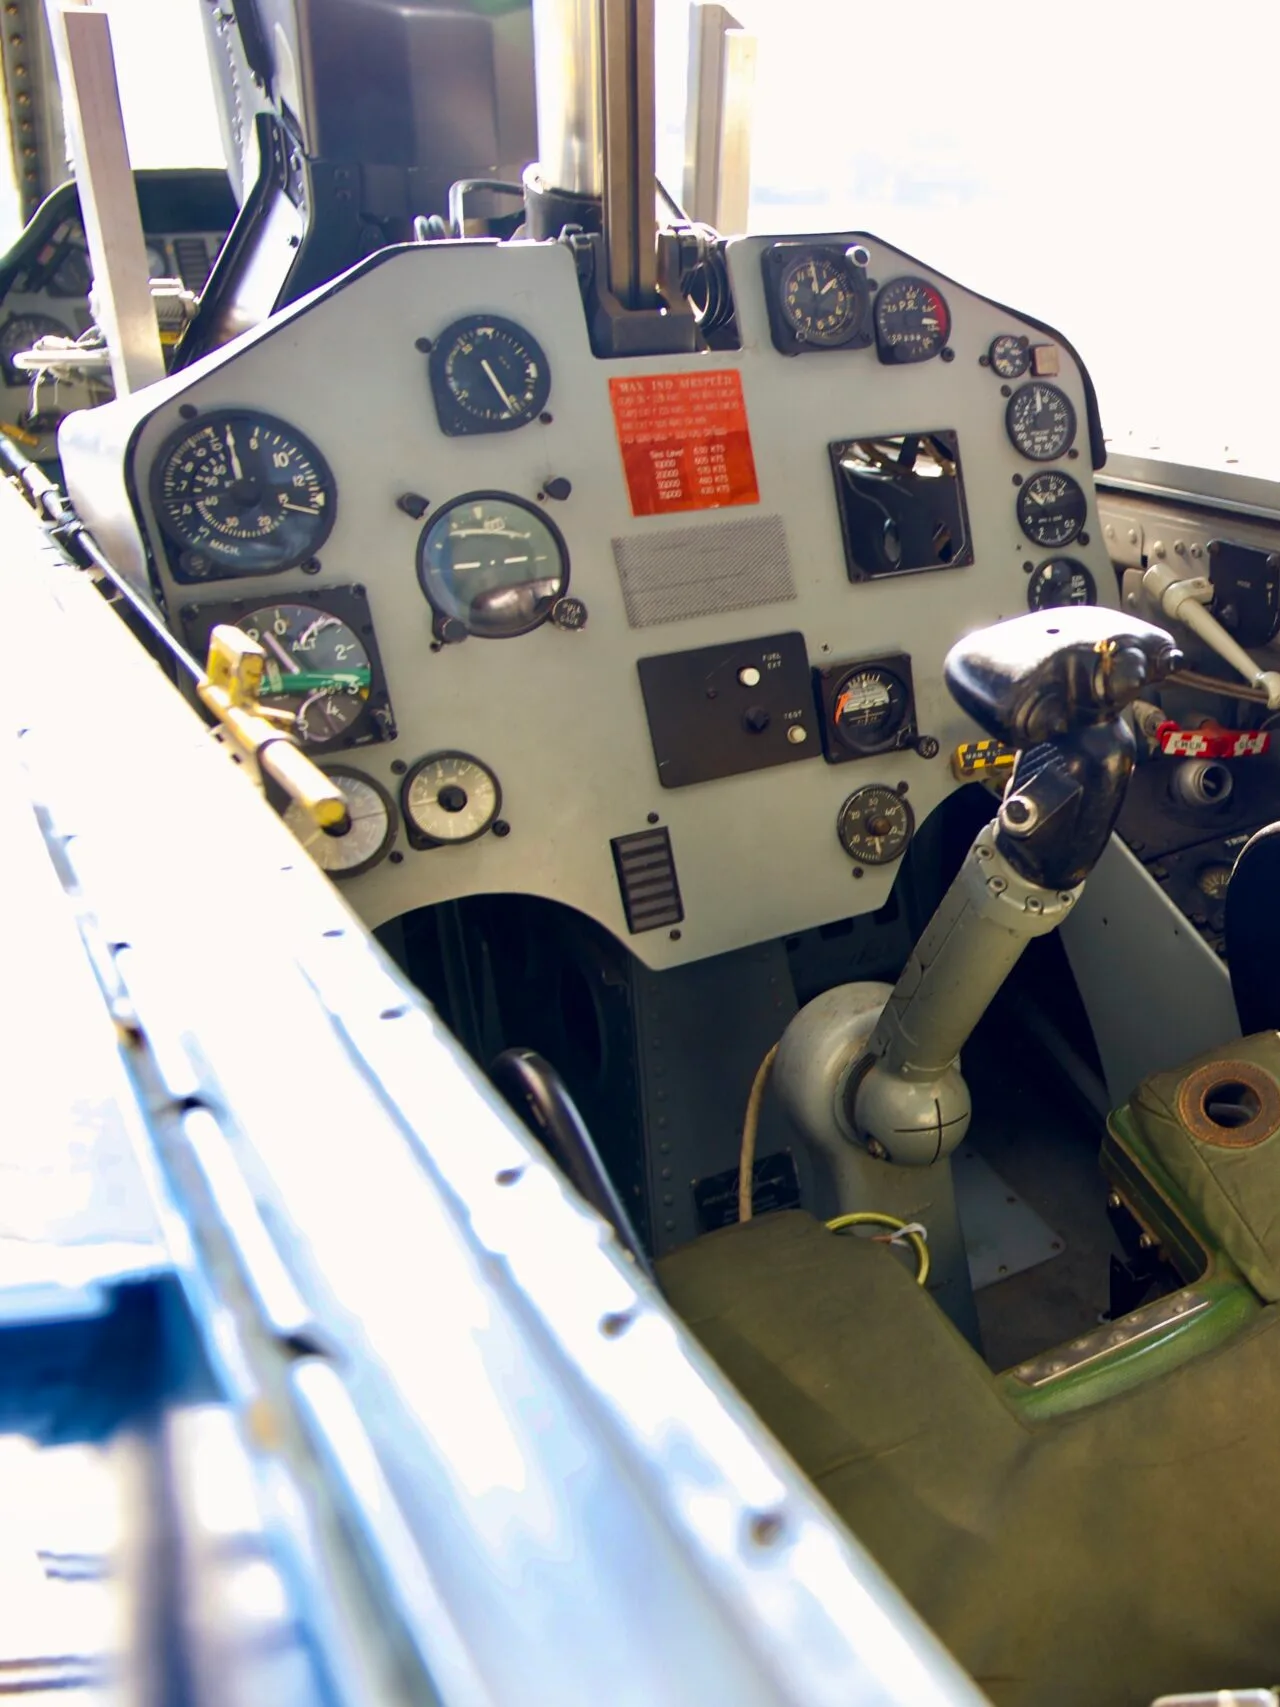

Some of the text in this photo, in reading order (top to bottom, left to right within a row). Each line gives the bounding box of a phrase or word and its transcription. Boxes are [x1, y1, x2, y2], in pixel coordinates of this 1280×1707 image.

[619, 382, 645, 394] MAX
[651, 379, 674, 391] IND
[273, 452, 291, 468] 10
[293, 475, 306, 488] 12
[272, 618, 288, 636] 0
[334, 643, 350, 662] 2
